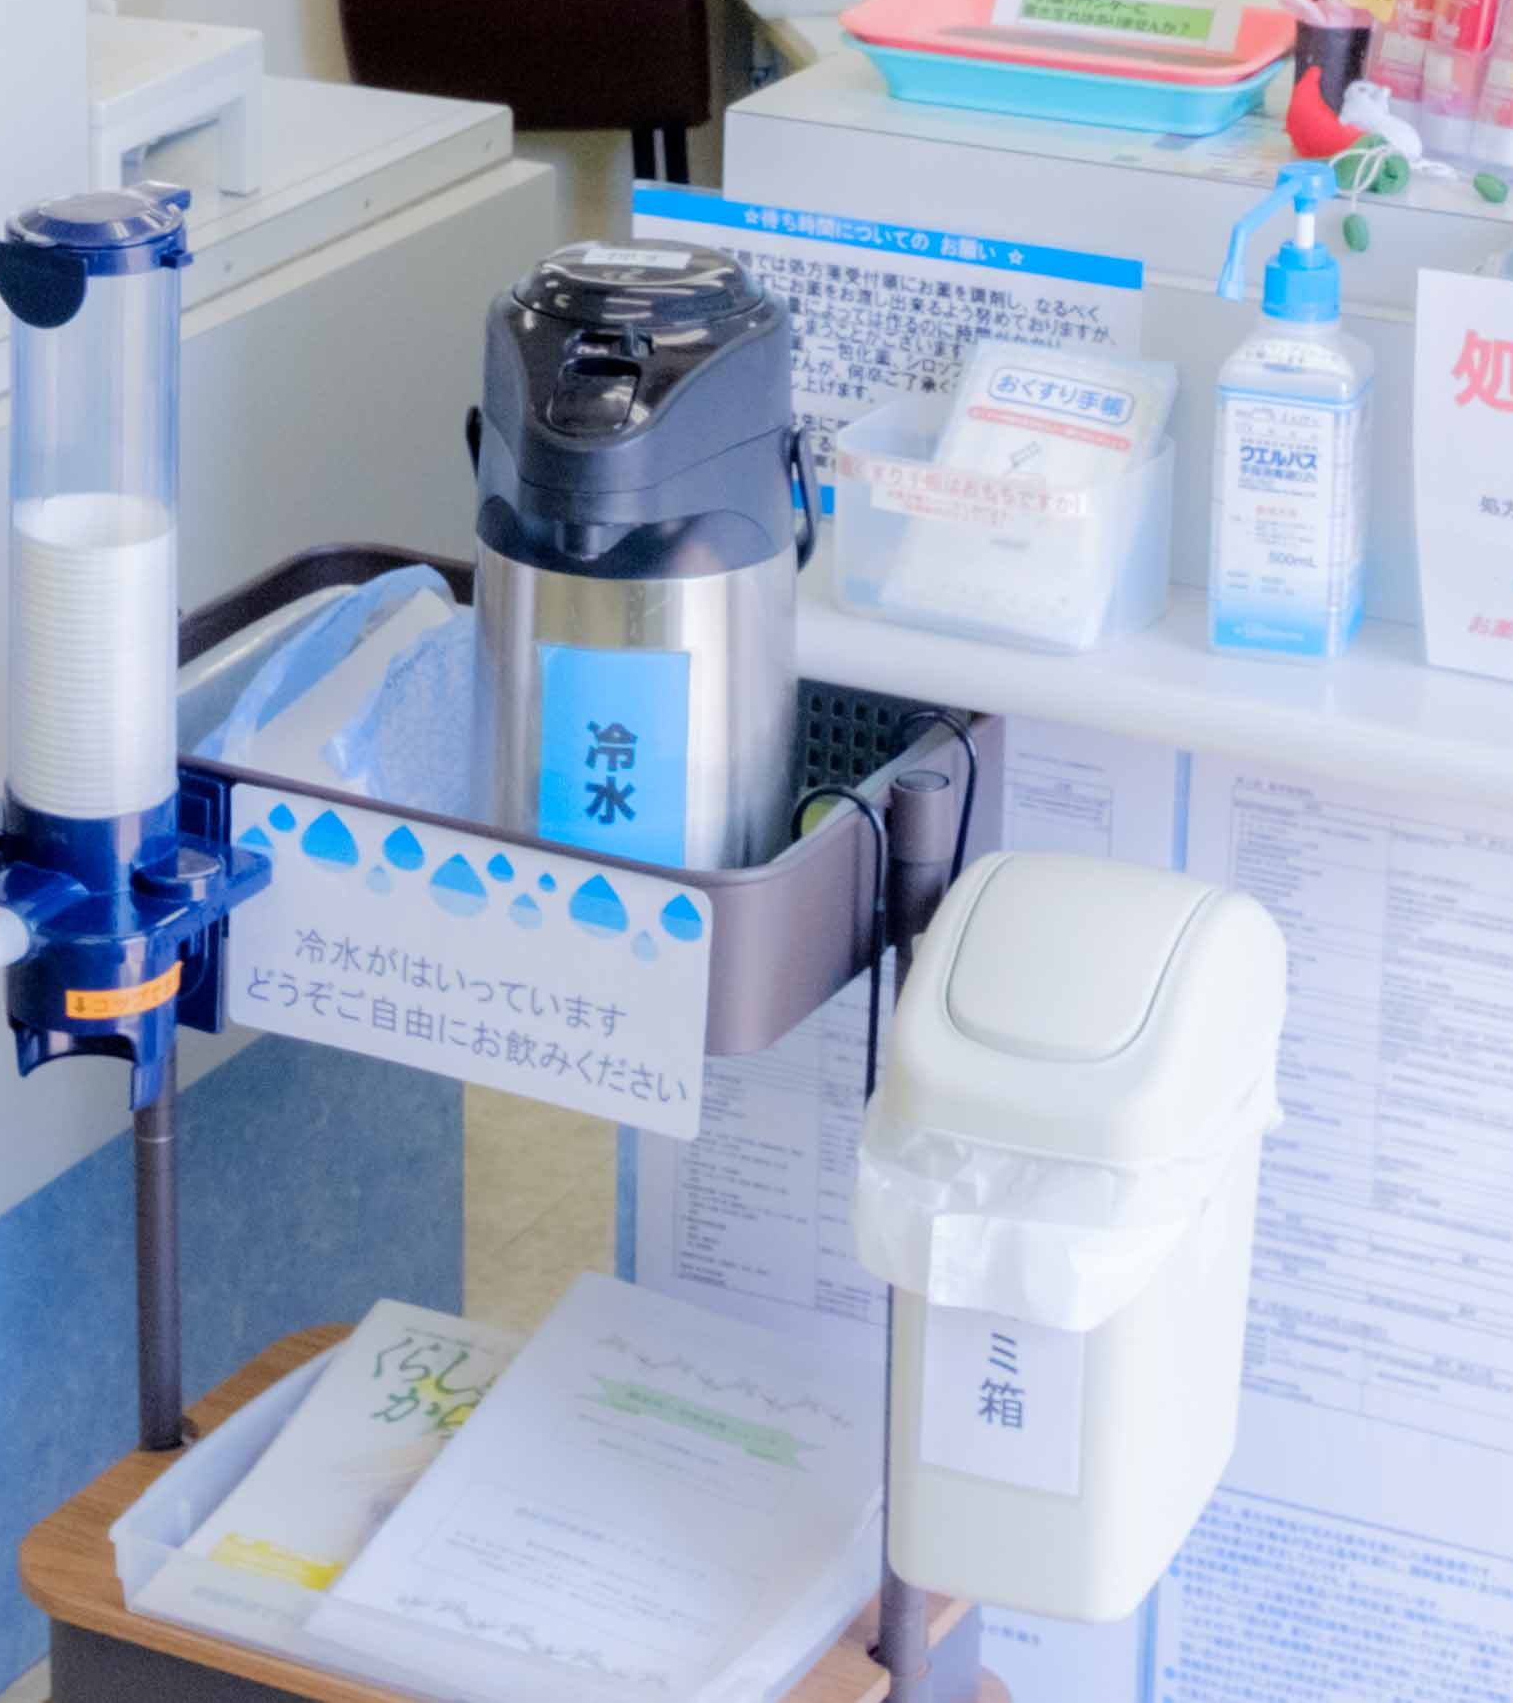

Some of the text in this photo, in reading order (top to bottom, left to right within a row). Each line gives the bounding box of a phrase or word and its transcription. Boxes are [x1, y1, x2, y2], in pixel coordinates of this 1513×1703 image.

[997, 374, 1126, 419] おくすり手帳
[585, 719, 640, 826] 冷水
[245, 965, 690, 1103] どうぞご自由にお飲みください
[293, 926, 629, 1040] 冷水がはいっています
[976, 1331, 1028, 1432] ミ箱
